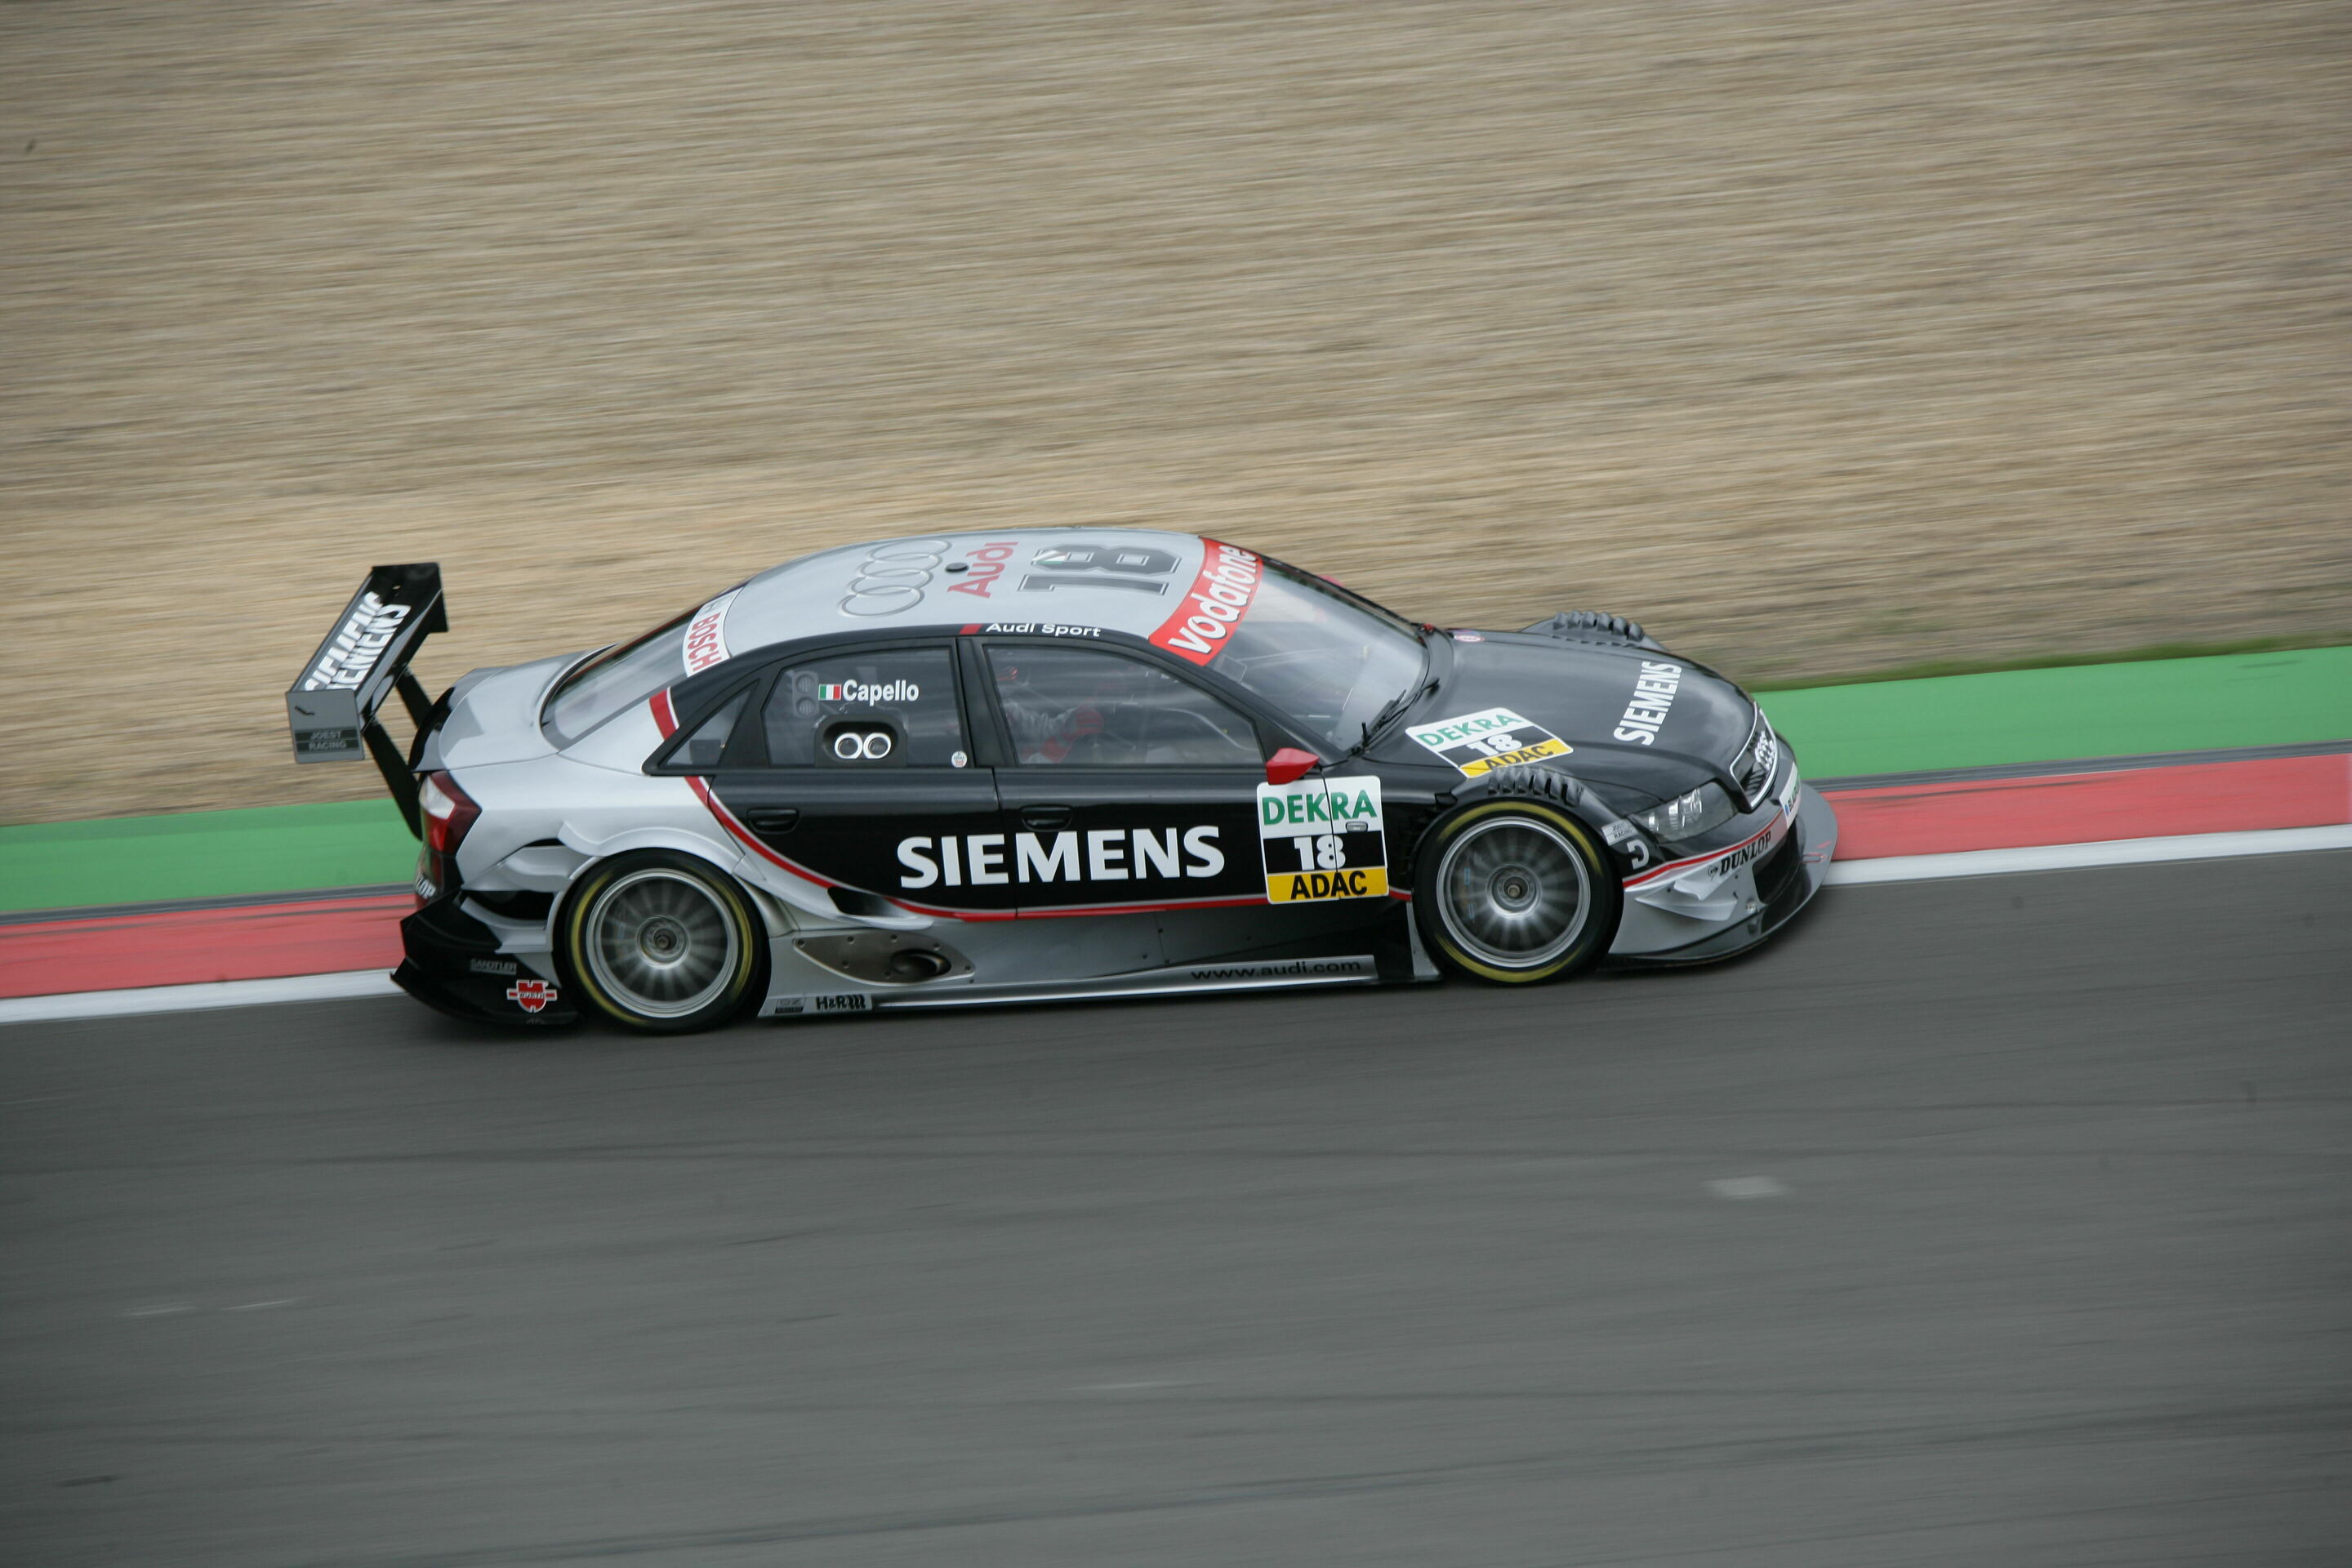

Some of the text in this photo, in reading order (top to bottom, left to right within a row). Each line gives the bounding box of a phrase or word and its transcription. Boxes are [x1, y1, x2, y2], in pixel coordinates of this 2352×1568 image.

[947, 541, 1019, 599] Audi
[1017, 544, 1182, 596] 18
[1168, 545, 1258, 654] vodafone
[688, 612, 722, 671] BOSCH
[986, 623, 1102, 637] Audi Sport
[842, 679, 920, 706] Capello
[1613, 661, 1682, 746] SIEMENS
[1416, 715, 1524, 746] DEKRA
[1467, 733, 1523, 757] 18
[1484, 746, 1554, 771] ADAC
[1262, 789, 1379, 826] DEKRA
[897, 825, 1225, 889] SIEMENS
[1294, 834, 1346, 871] 18
[1720, 831, 1771, 876] DUNLOP
[1290, 871, 1368, 900] ADAC
[1191, 961, 1361, 980] www.audi.com
